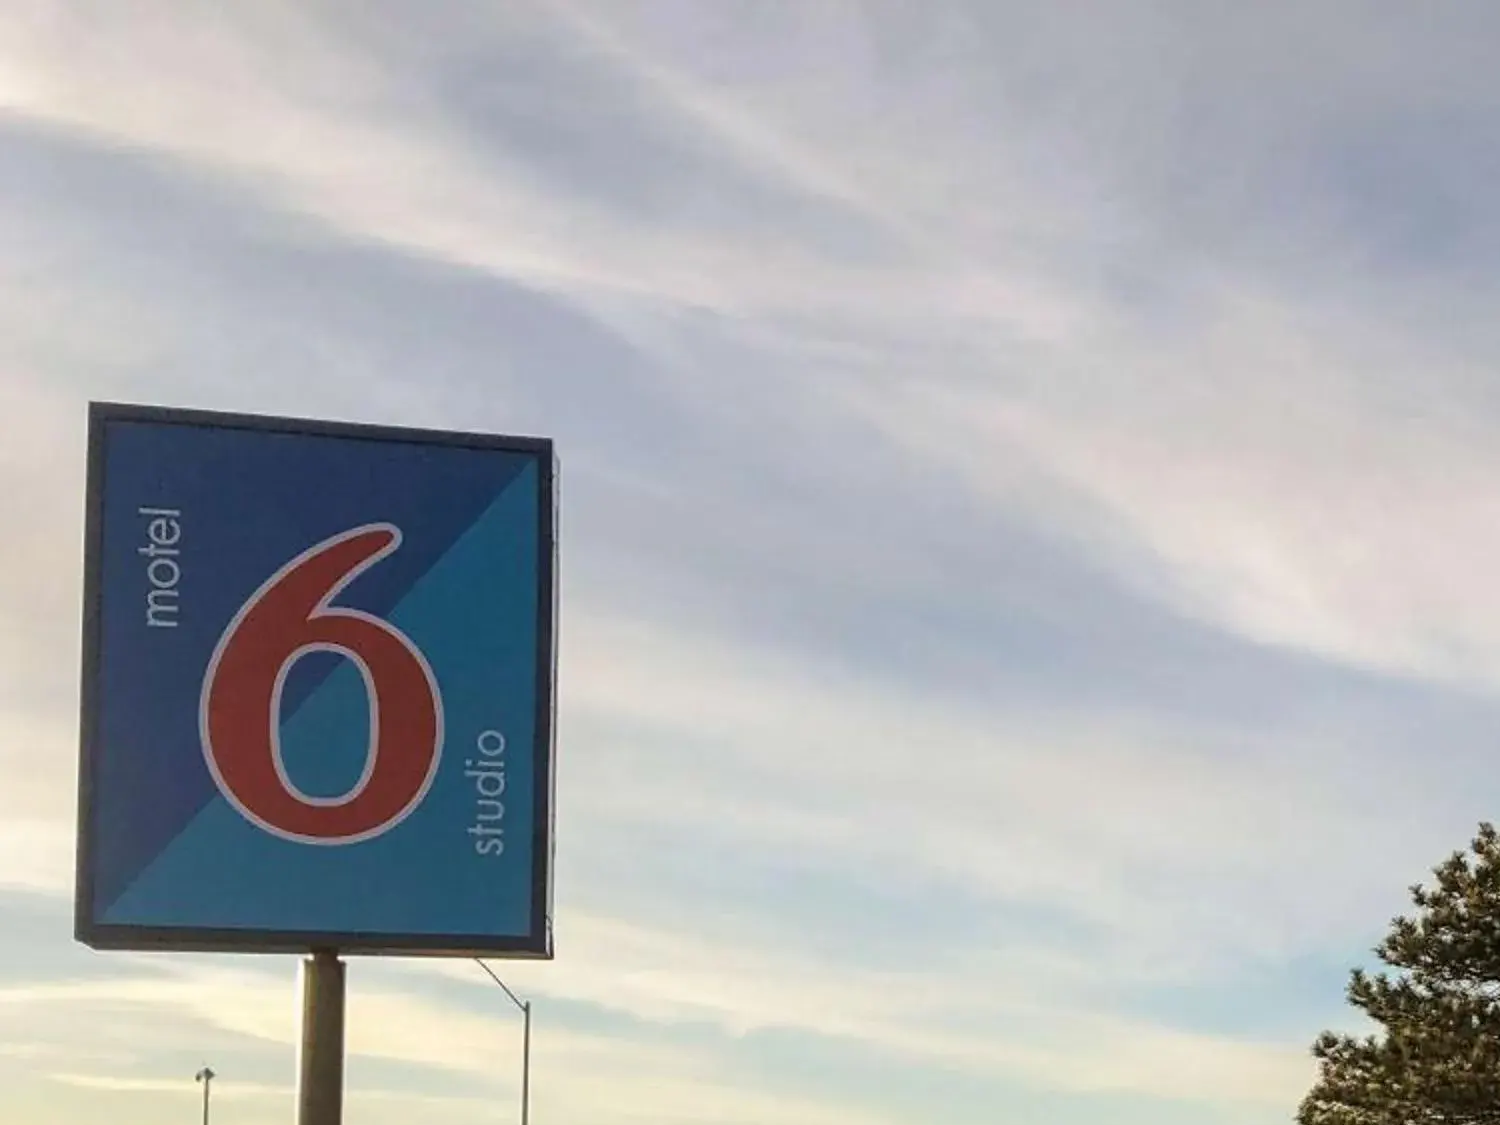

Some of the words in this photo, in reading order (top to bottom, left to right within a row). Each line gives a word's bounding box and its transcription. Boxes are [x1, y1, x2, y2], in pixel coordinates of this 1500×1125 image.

[139, 507, 181, 627] motel
[199, 522, 444, 845] 6
[464, 729, 506, 856] studio
